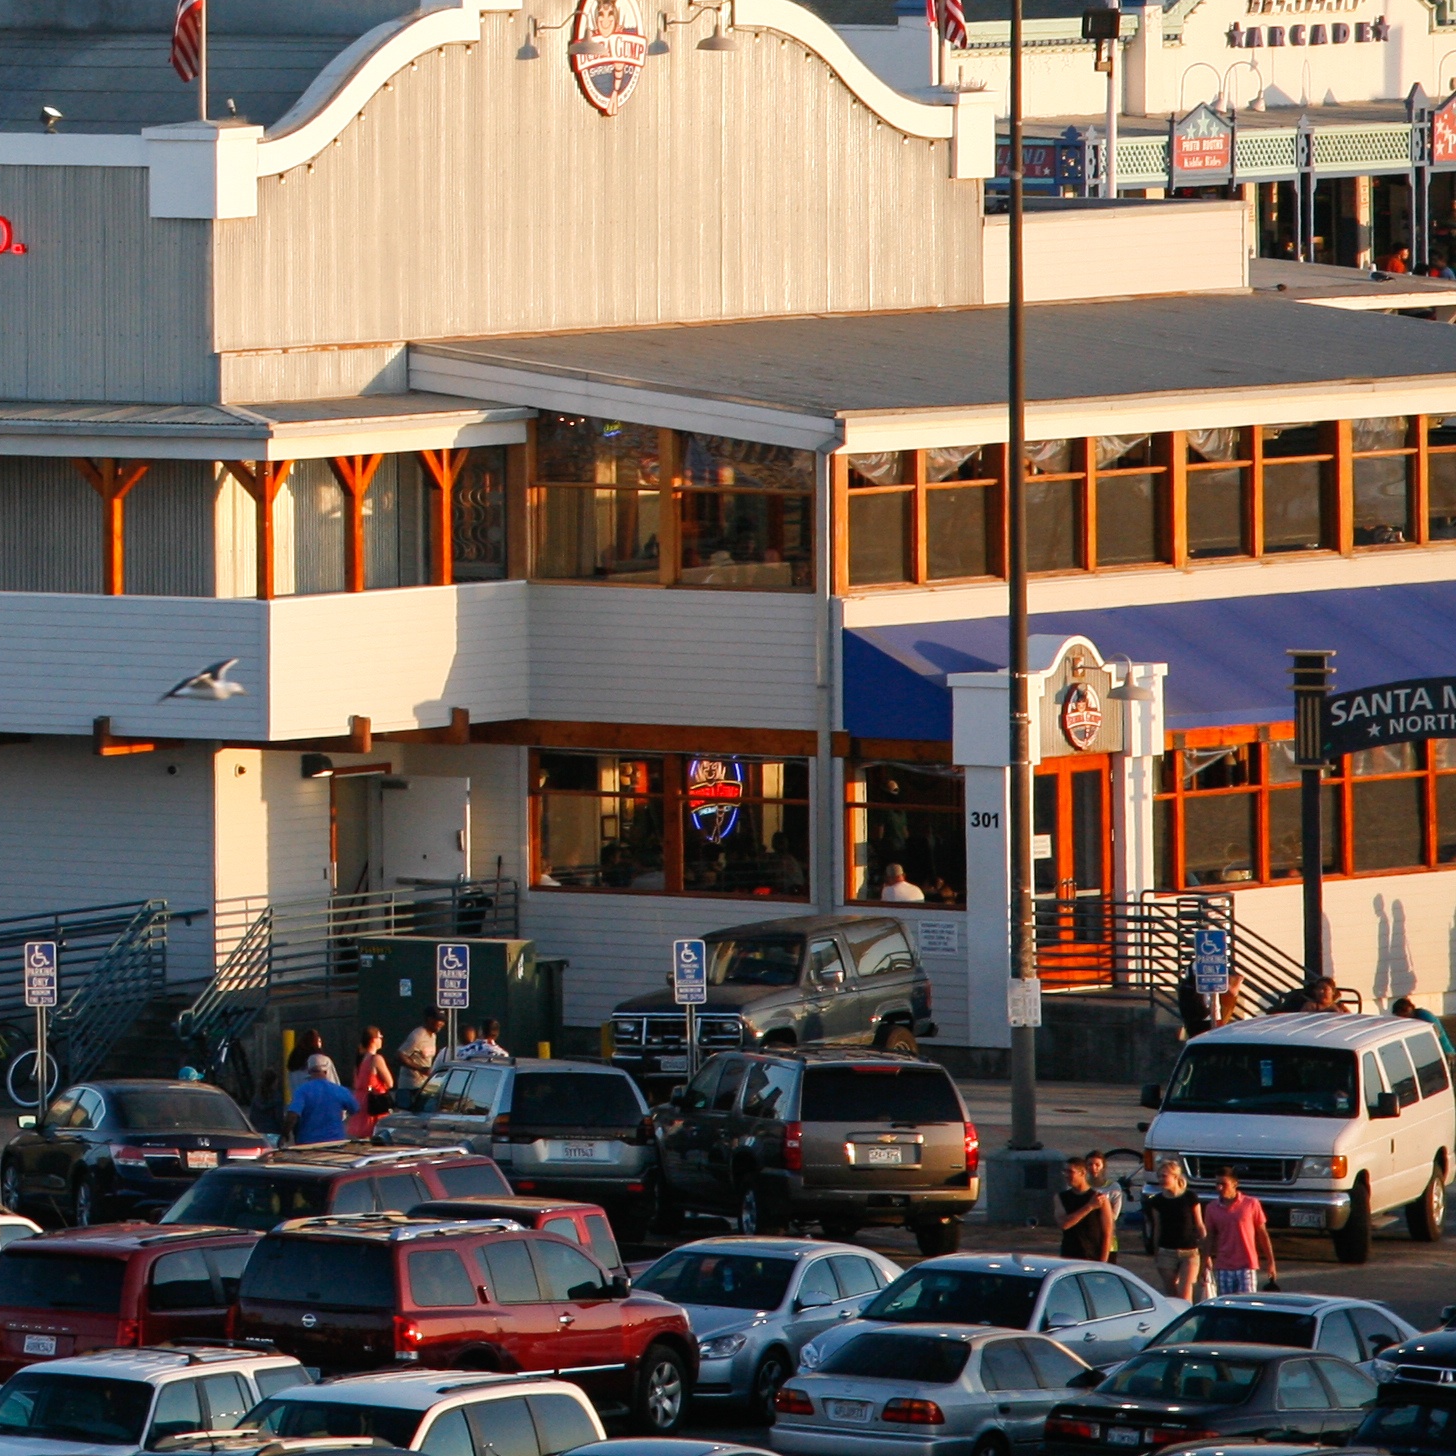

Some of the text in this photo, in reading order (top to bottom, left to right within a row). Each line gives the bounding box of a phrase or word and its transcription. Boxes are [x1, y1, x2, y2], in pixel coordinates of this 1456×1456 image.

[1245, 22, 1372, 48] ARCADE
[615, 36, 644, 59] GUMP
[1331, 686, 1434, 727] SANTA
[970, 811, 999, 829] 301
[1198, 955, 1227, 964] PARKING
[27, 967, 55, 976] PARKING
[439, 969, 468, 979] PARKING
[1202, 965, 1221, 975] ONLY
[33, 977, 48, 987] ONLY
[444, 980, 461, 989] ONLY
